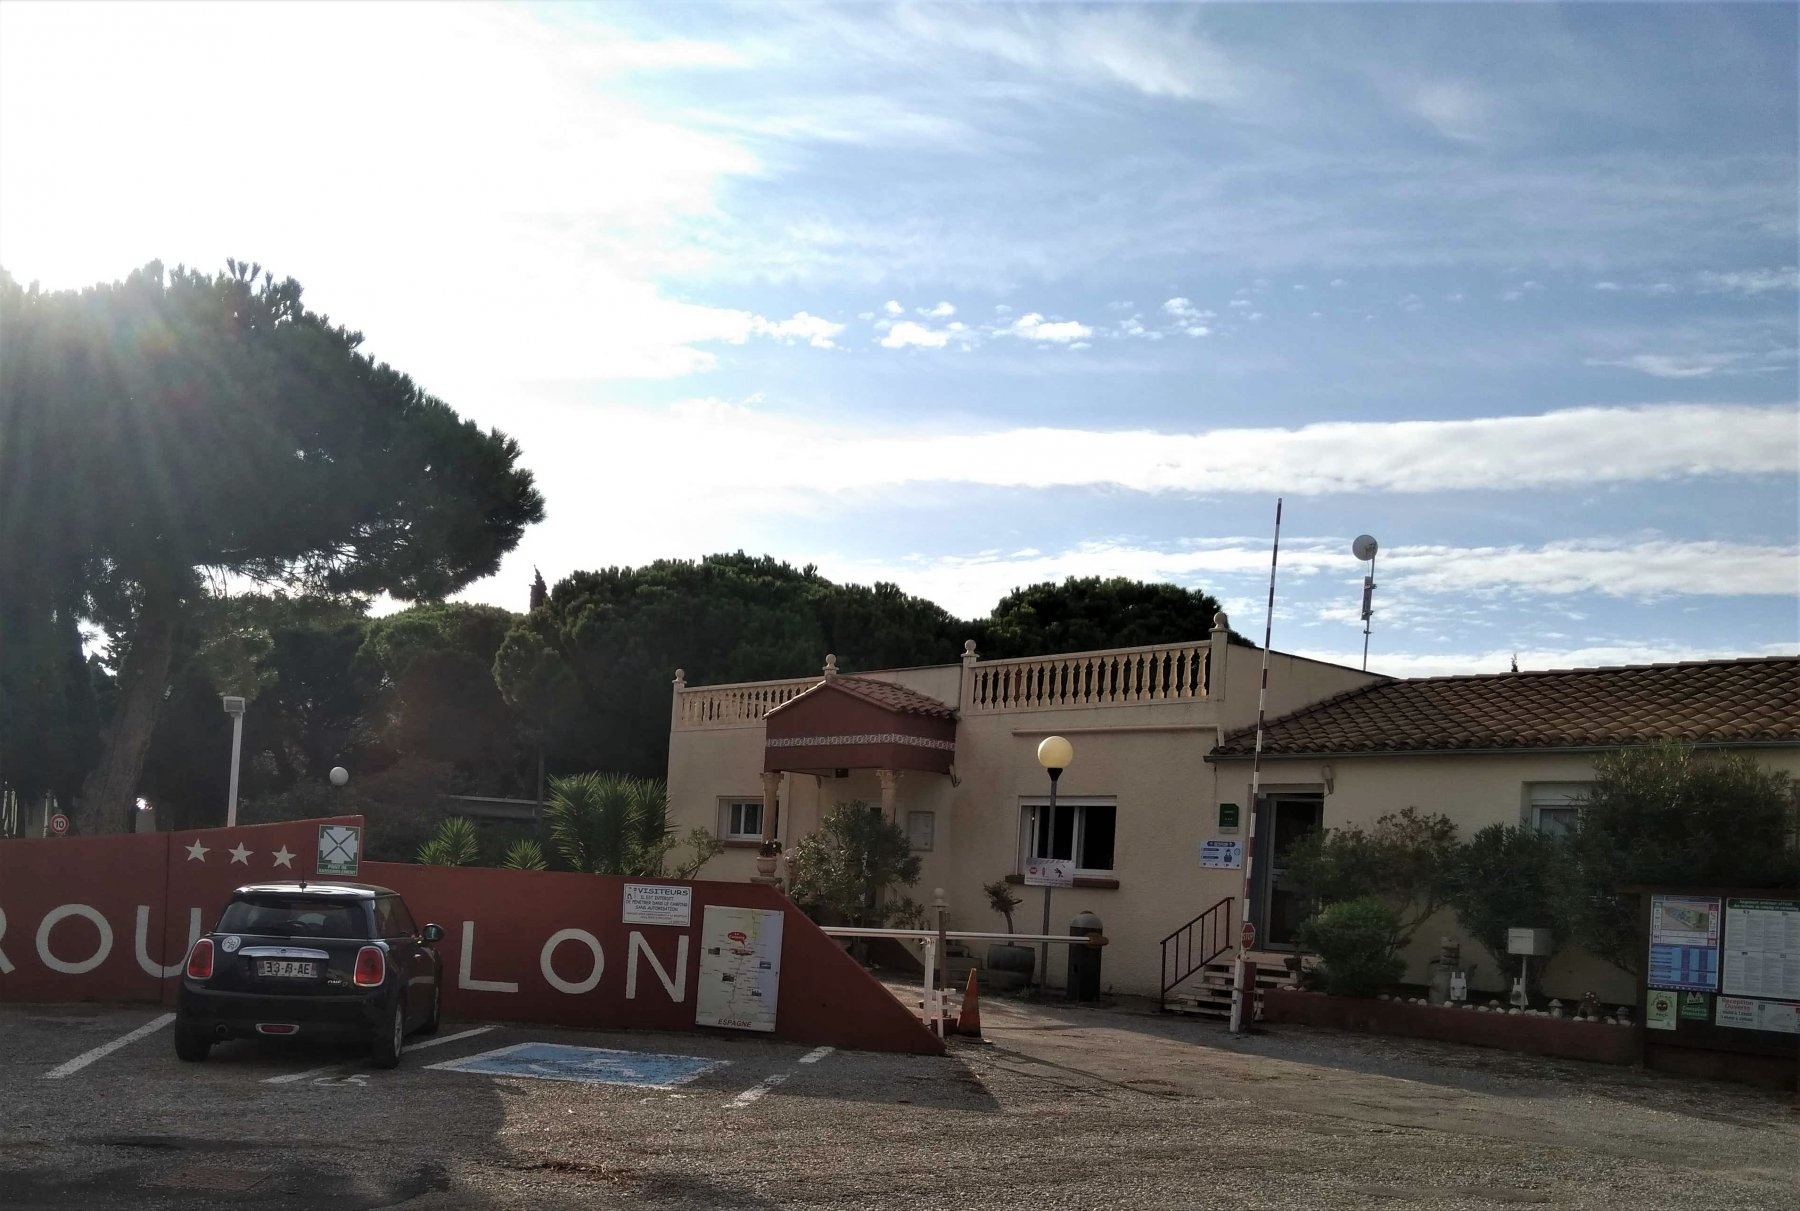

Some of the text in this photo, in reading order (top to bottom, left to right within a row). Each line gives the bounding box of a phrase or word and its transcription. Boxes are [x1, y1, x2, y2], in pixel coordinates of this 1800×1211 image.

[55, 820, 65, 829] 10
[638, 887, 688, 896] VISITEURS
[717, 1018, 753, 1028] ESPAGNE
